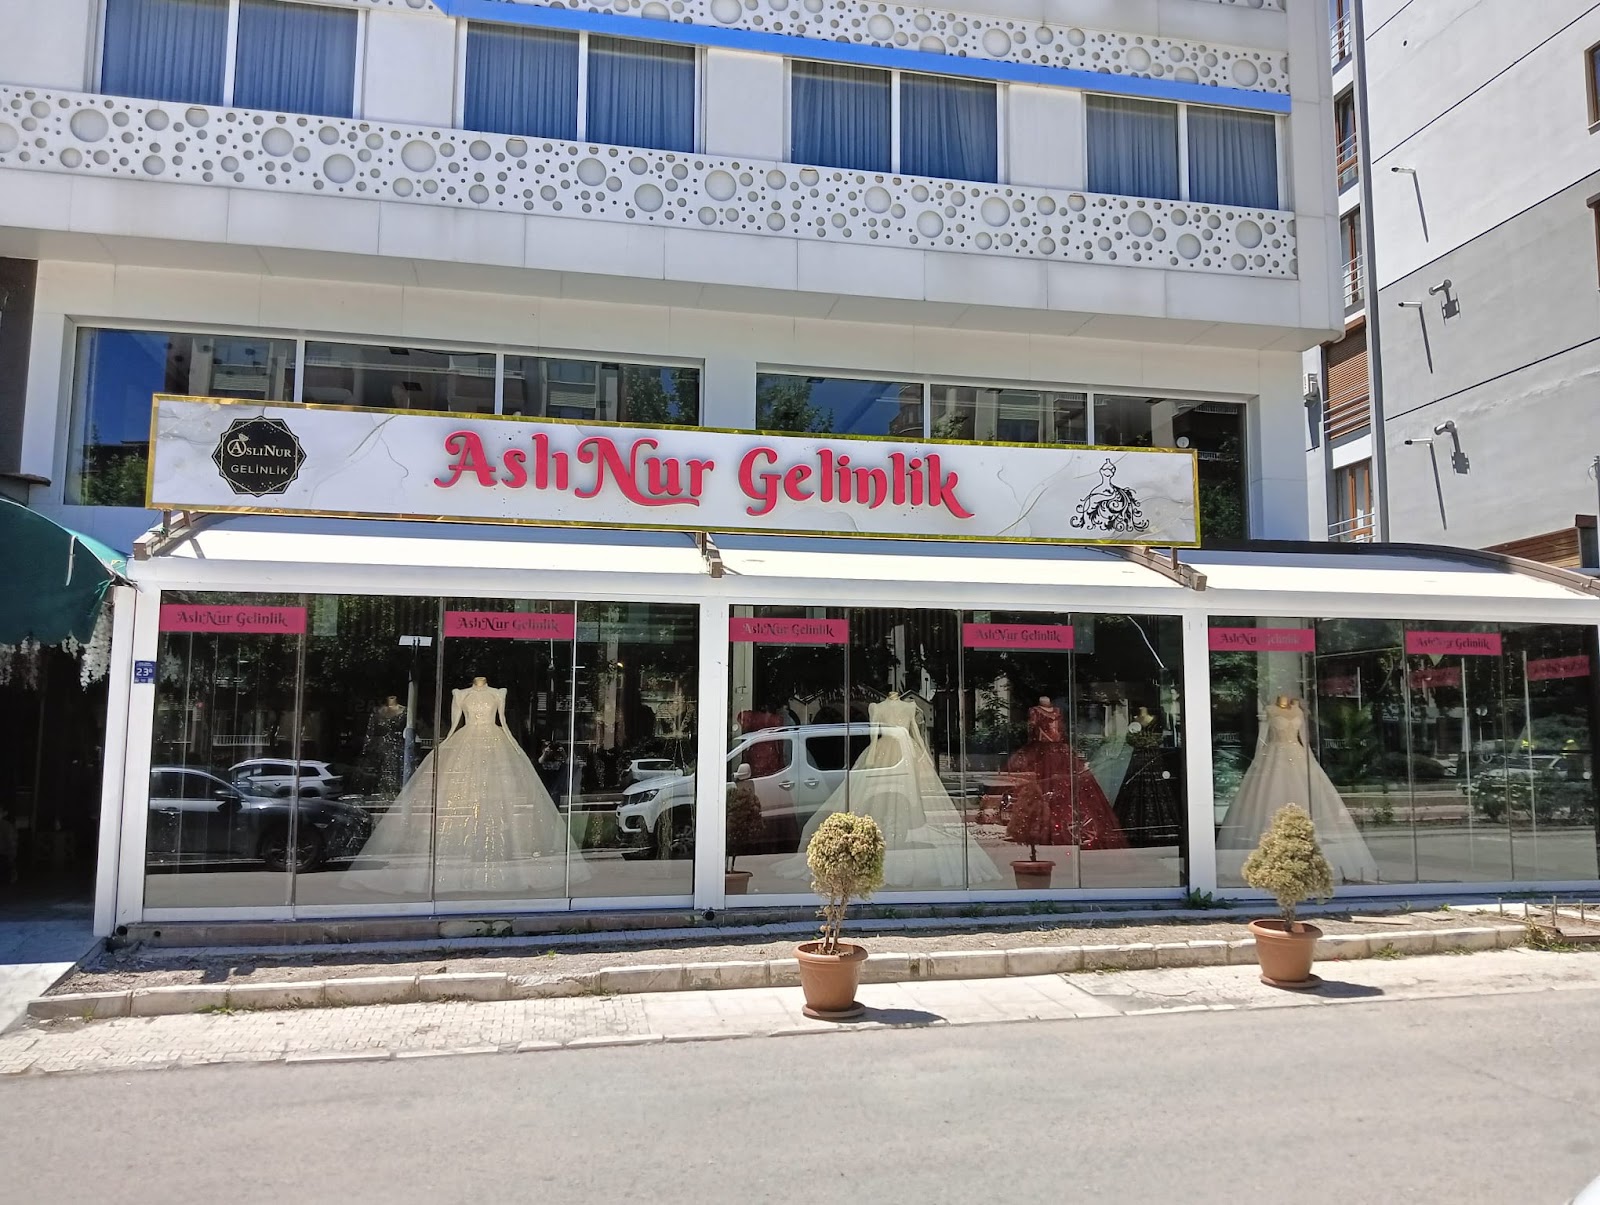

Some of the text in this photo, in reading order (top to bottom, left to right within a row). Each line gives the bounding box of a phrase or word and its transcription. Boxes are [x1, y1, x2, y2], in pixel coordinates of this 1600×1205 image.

[230, 464, 289, 475] GELİNLİK
[738, 446, 975, 520] Gelinlik
[236, 612, 288, 628] Gelinlik
[1021, 629, 1062, 643] Gelinlik
